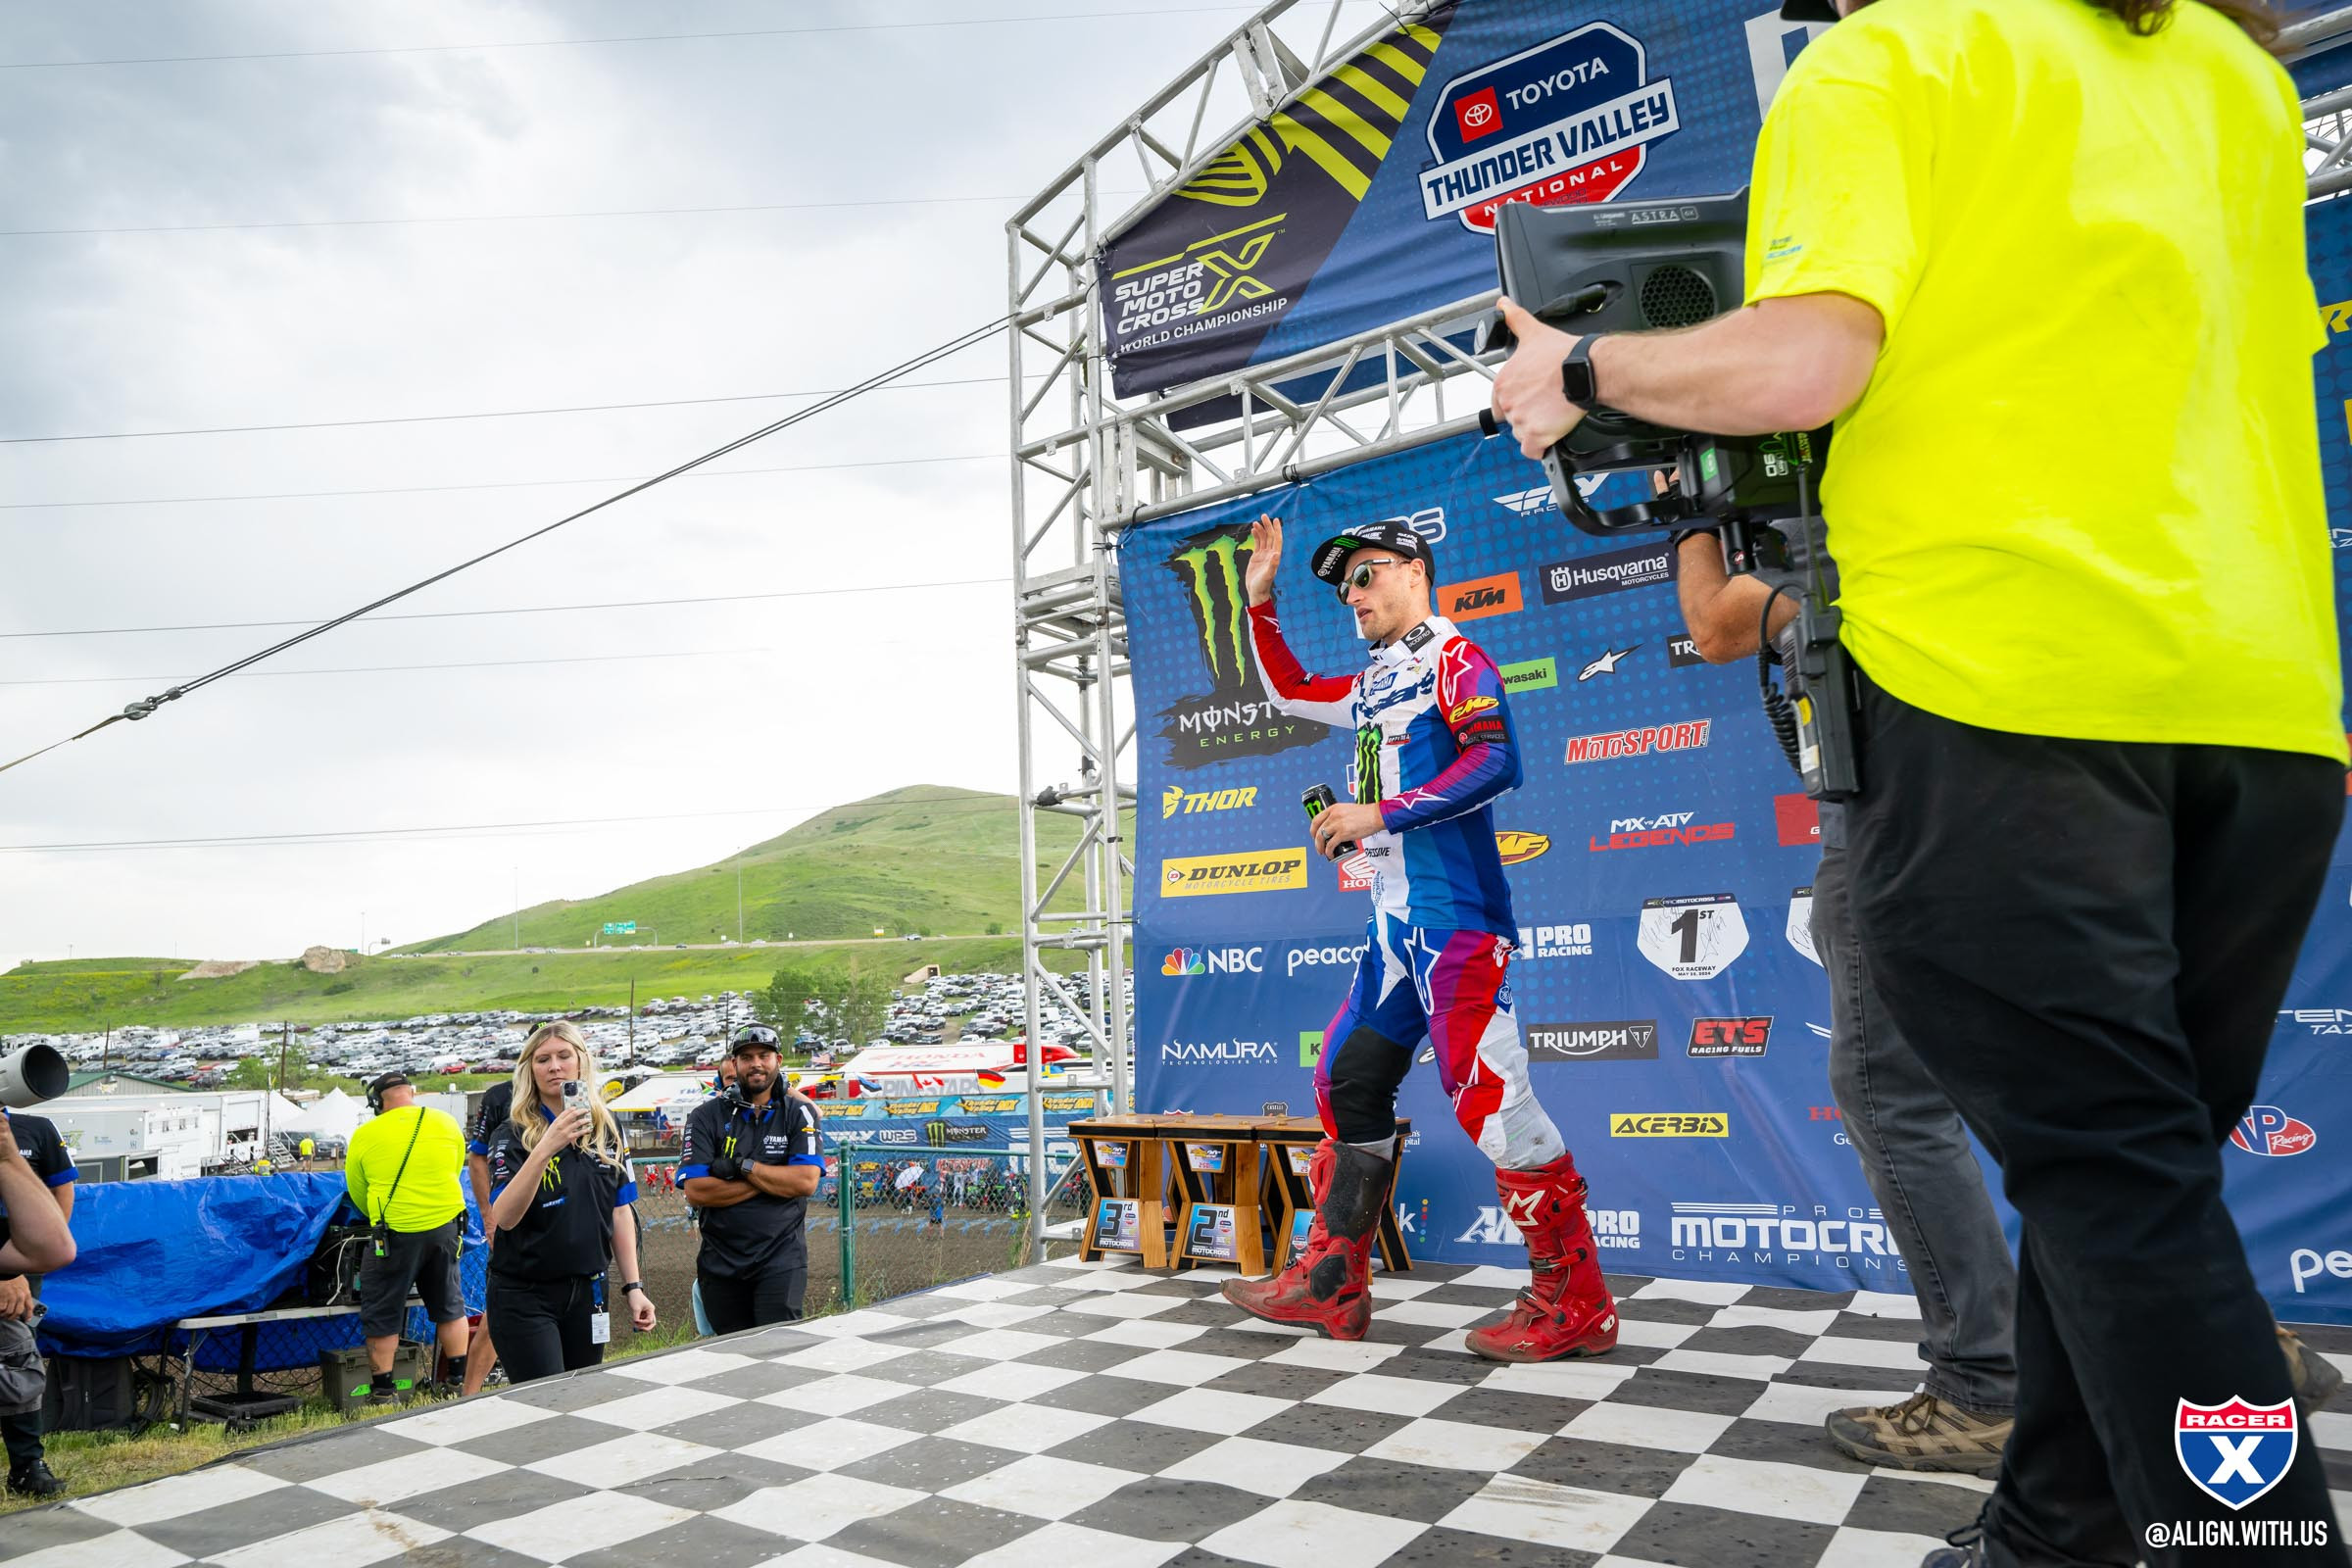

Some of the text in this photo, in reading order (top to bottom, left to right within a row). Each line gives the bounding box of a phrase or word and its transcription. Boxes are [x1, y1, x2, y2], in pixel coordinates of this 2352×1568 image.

[1505, 57, 1610, 111] TOYOTA
[1427, 91, 1671, 208] THUNDER VALLEY
[1632, 211, 1680, 222] ASTRA
[1114, 262, 1205, 303] SUPER
[1121, 280, 1202, 318] MOTO
[1116, 296, 1205, 335] CROSS
[1120, 297, 1289, 354] WORLD CHAMPIONSHIP
[1573, 556, 1667, 587] Husqvarna
[1621, 571, 1669, 586] MOTORCYCLES
[1453, 586, 1505, 613] KTM
[1504, 667, 1547, 685] wasaki
[1179, 701, 1273, 734] MONST
[1200, 725, 1296, 748] ENERGY
[1184, 786, 1258, 814] THOR
[1610, 817, 1645, 833] MX
[1651, 811, 1694, 830] ATV
[1497, 833, 1548, 857] MF
[1589, 822, 1736, 852] LEGENDS
[1187, 859, 1301, 881] DUNLOP
[1184, 875, 1292, 890] MOTORCYCLE TIRES
[1343, 879, 1372, 889] HON
[1536, 924, 1592, 947] PRO
[1208, 947, 1263, 974] NBC
[1287, 946, 1363, 977] peaco
[1538, 945, 1592, 957] RACING
[1530, 1029, 1628, 1053] TRIUMPH
[1693, 1020, 1771, 1046] ETS
[1162, 1037, 1278, 1060] NAMURA
[1691, 1045, 1763, 1054] RACING FUELS
[879, 1129, 917, 1144] WPS
[946, 1126, 987, 1136] MONSTER
[1404, 1137, 1420, 1147] pital
[2271, 1131, 2314, 1150] Racing
[1783, 1205, 1864, 1219] PRO
[1671, 1216, 1900, 1255] MOTOCR
[1672, 1250, 1907, 1272] CHAMPIONS
